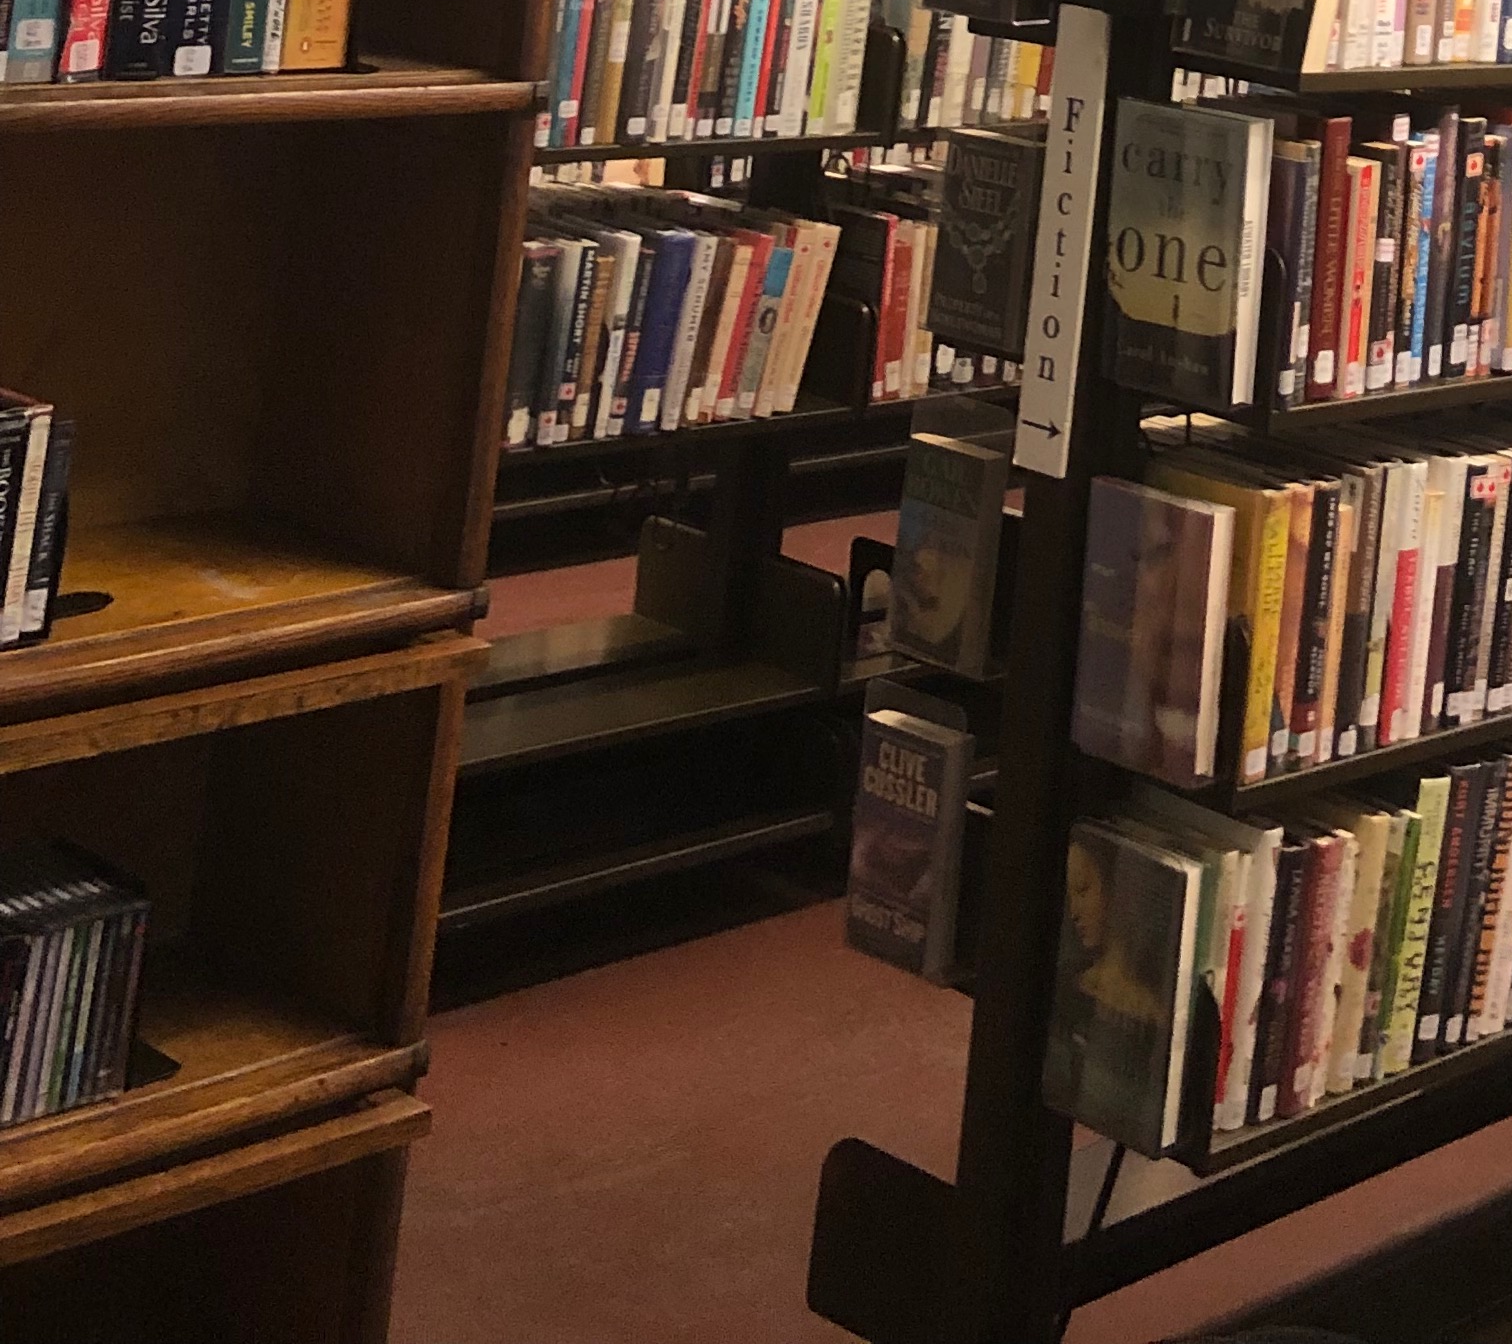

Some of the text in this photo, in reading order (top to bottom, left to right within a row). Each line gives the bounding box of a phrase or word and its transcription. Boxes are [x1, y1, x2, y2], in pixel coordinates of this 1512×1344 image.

[240, 1, 255, 48] SMILEY
[1120, 136, 1231, 206] carry
[1037, 98, 1085, 383] Fiction
[1114, 223, 1229, 292] one
[1455, 201, 1479, 306] asylum
[572, 249, 596, 343] MARTIN SHORT
[685, 243, 712, 343] AMY SCHUMER
[1321, 260, 1338, 325] WOMEN
[863, 764, 940, 819] CUSSLER
[878, 739, 927, 786] CLIVE
